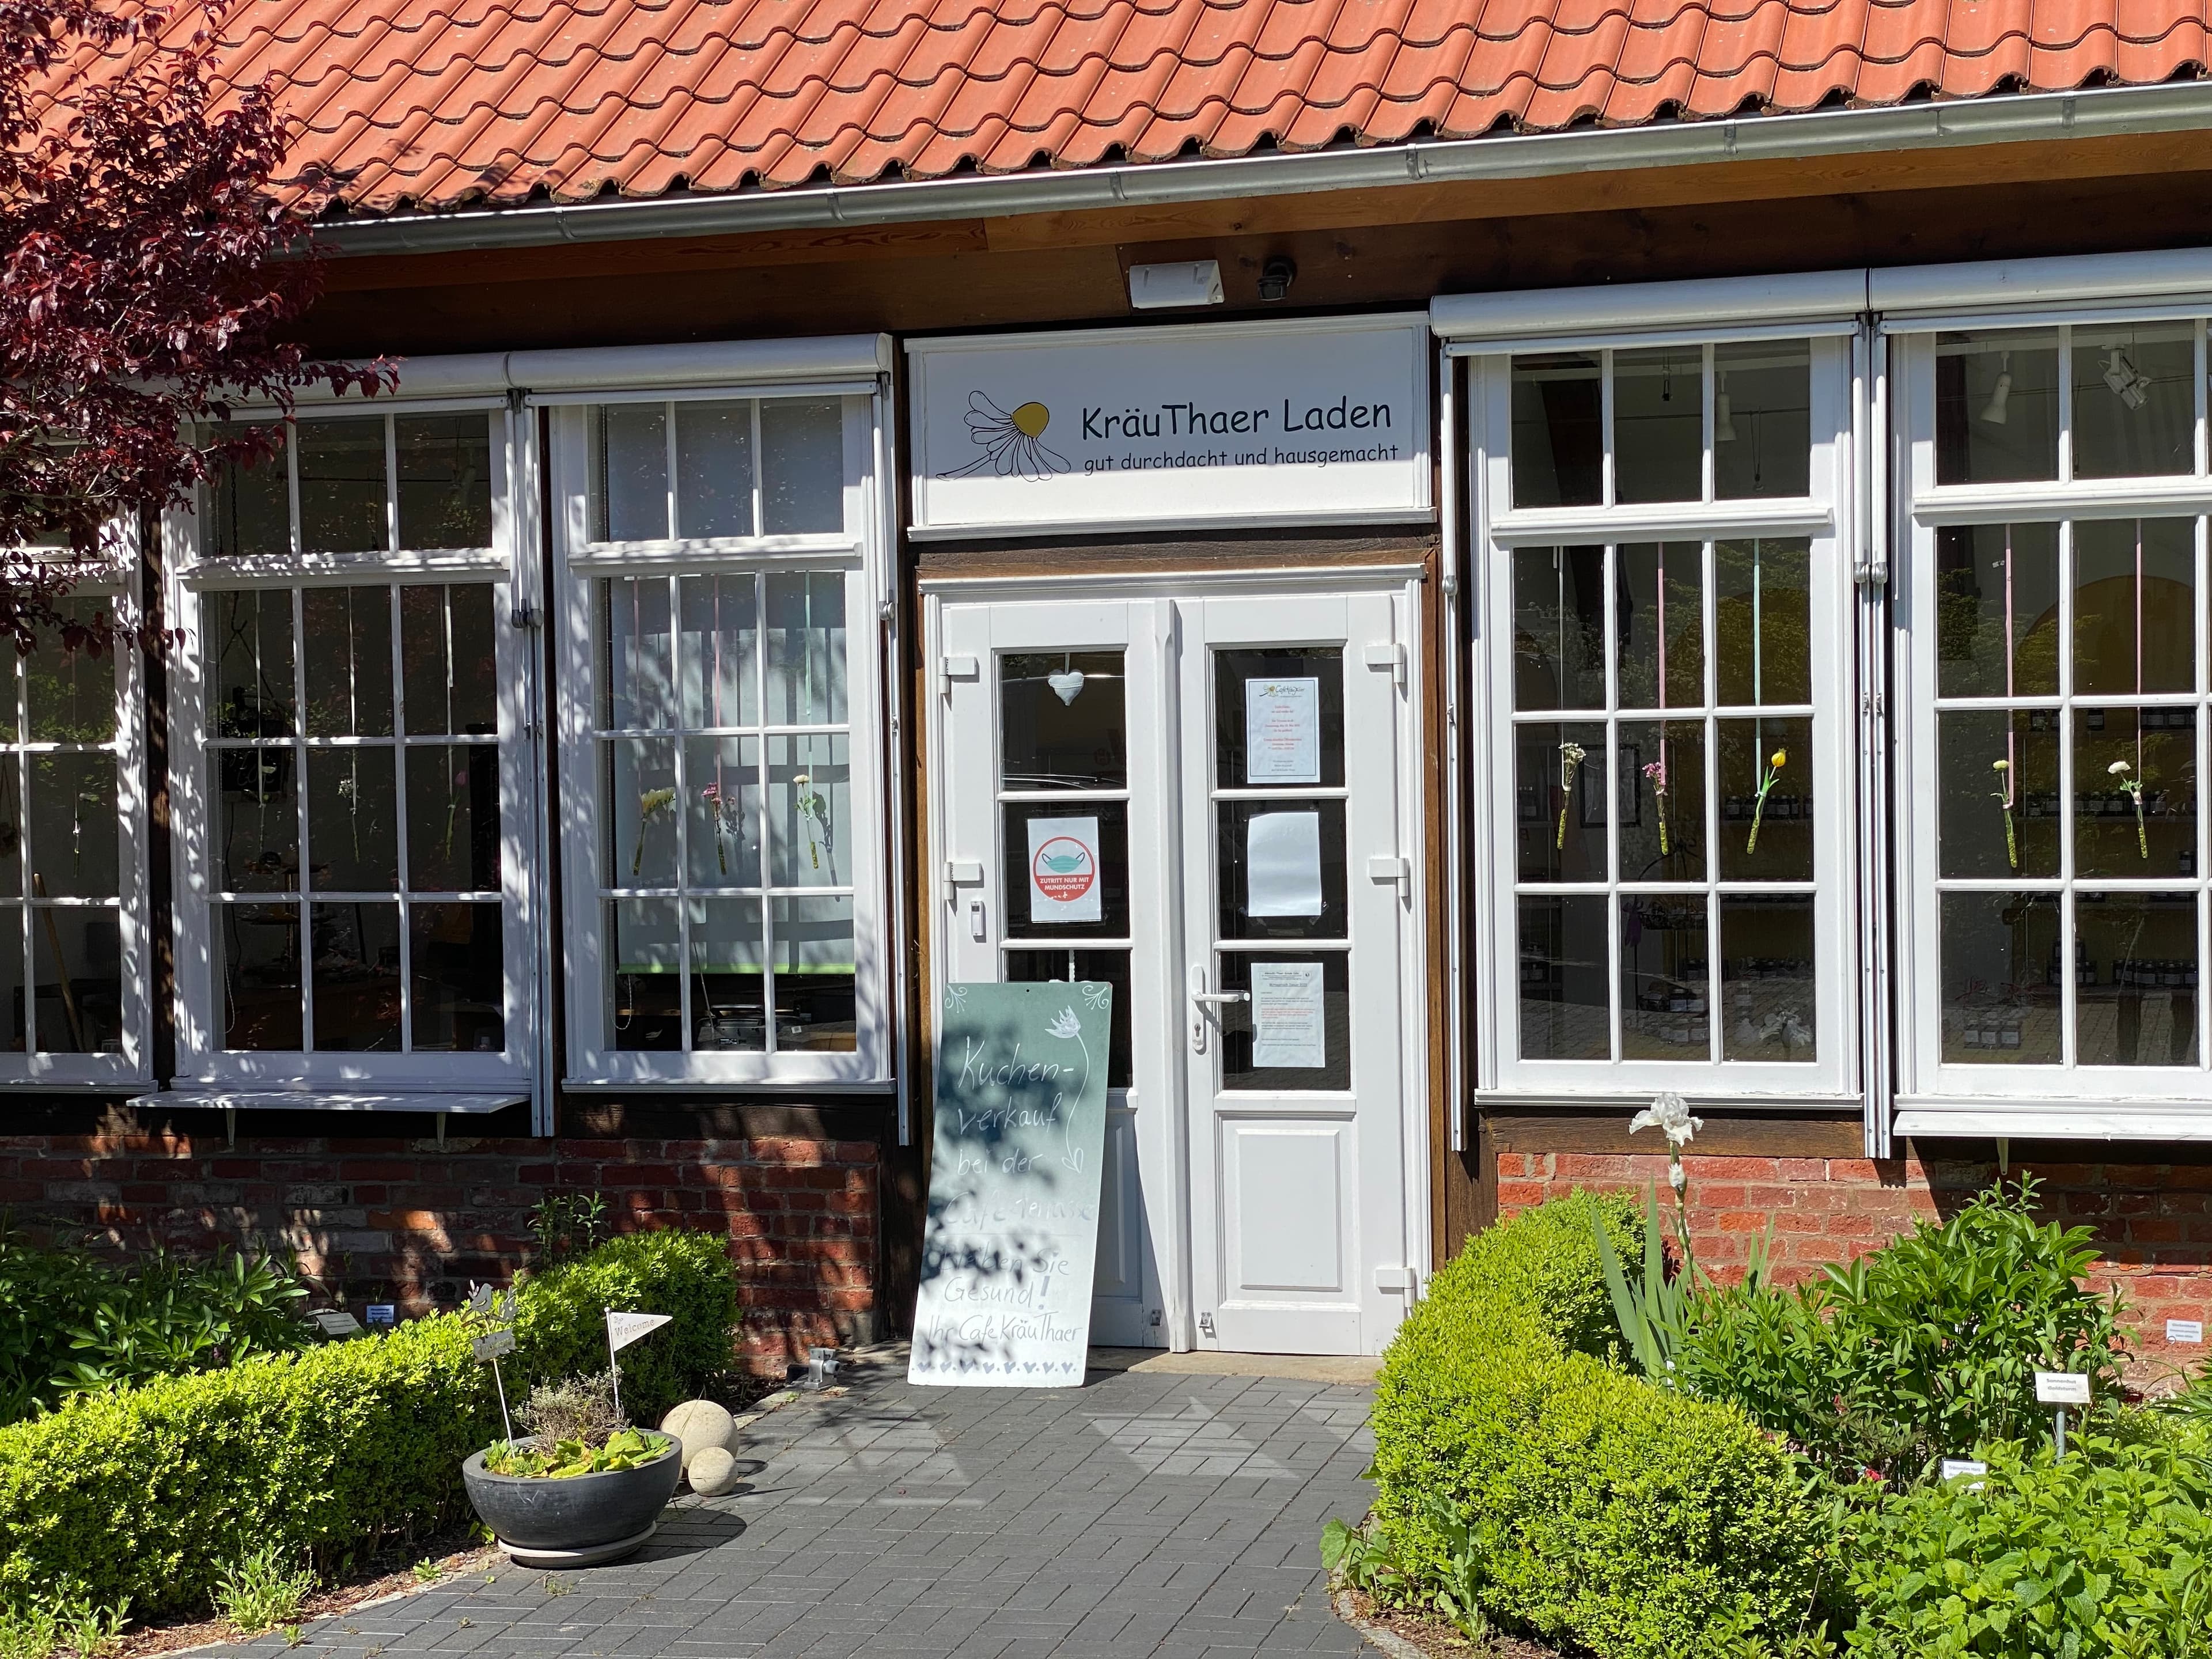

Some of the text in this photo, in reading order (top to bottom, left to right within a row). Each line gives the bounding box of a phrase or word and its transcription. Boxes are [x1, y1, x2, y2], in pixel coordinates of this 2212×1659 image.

[1083, 395, 1391, 440] KräuThaer Laden
[1084, 443, 1399, 476] gut durchdacht und hausgemacht
[957, 1036, 1075, 1089] Kuchen-
[957, 1147, 1044, 1175] bei der
[1033, 1247, 1070, 1275] Sie
[614, 1319, 655, 1336] Welcome
[927, 1315, 954, 1344] Ihr
